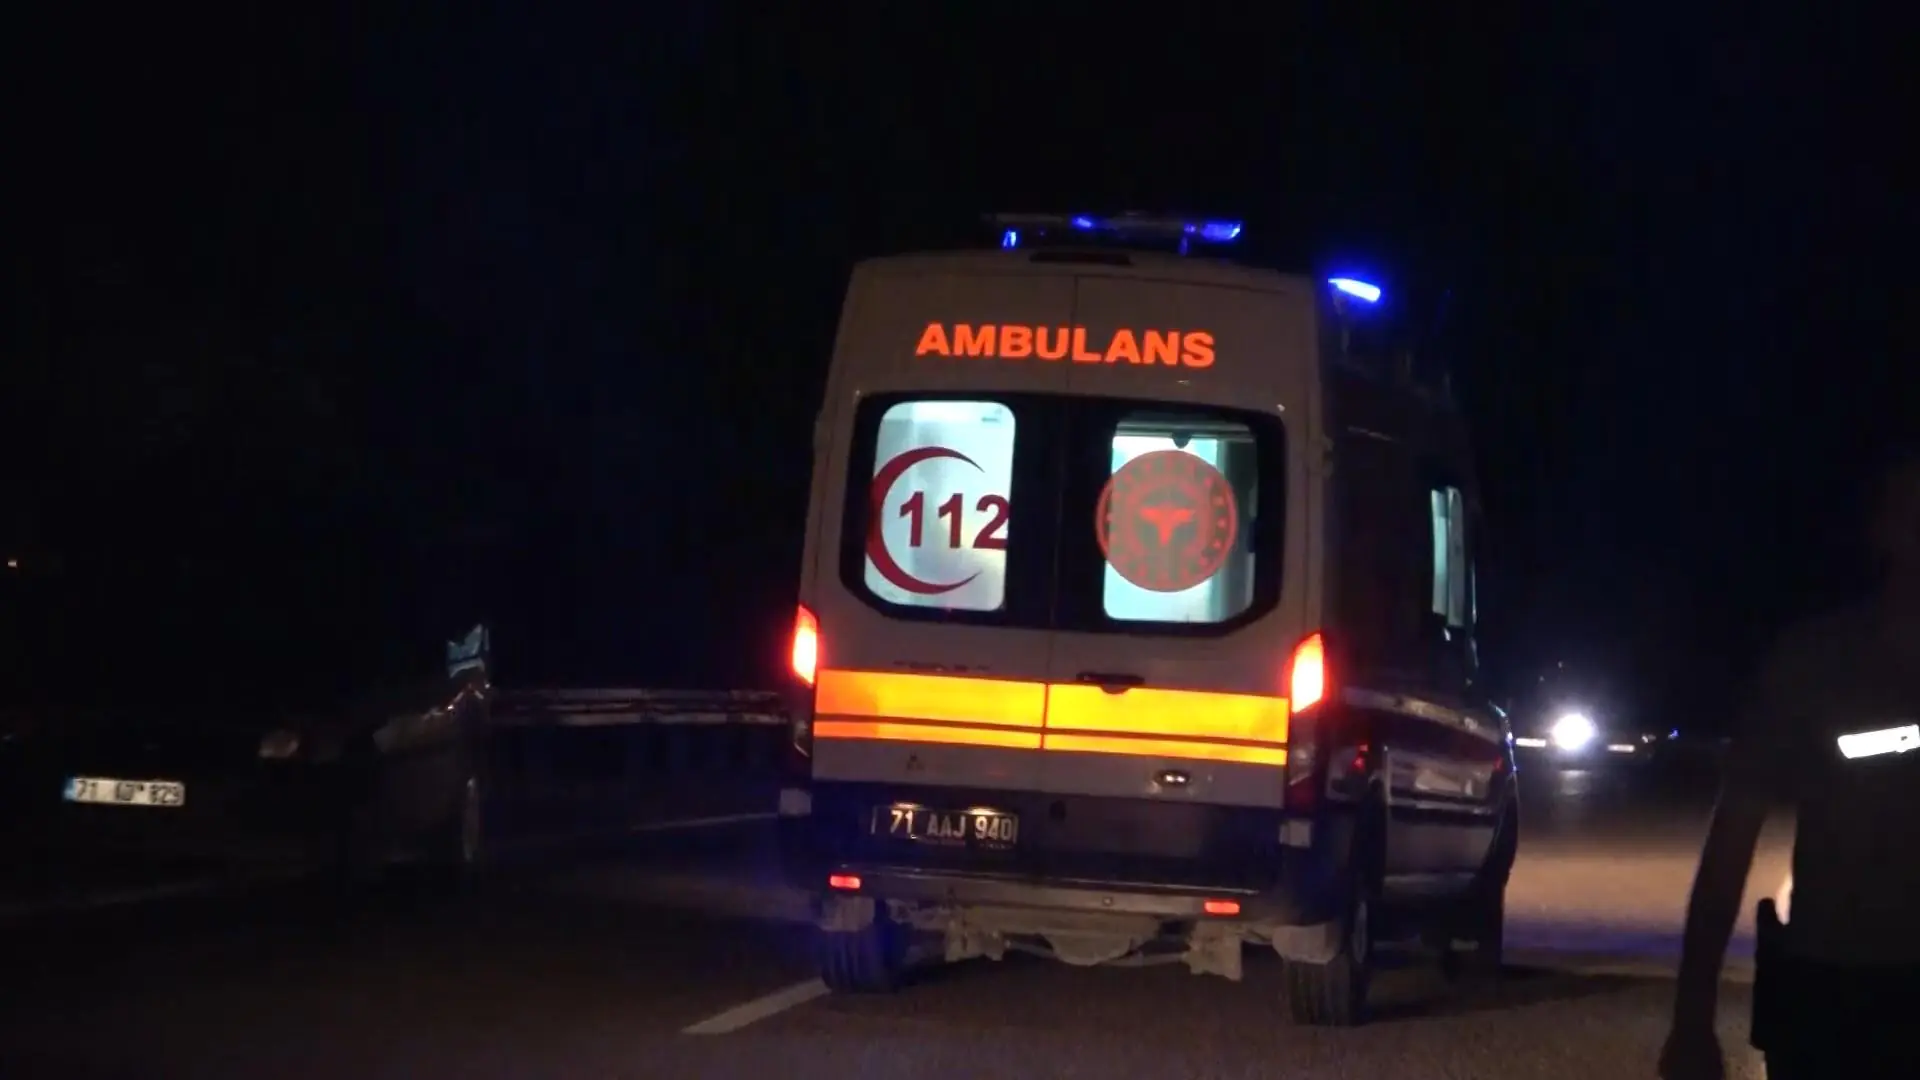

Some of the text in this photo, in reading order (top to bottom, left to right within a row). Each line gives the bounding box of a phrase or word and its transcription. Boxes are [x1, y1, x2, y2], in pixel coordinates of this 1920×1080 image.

[916, 323, 1214, 367] AMBULANS
[899, 491, 1012, 550] 112
[889, 809, 1012, 841] 71 AAJ 940
